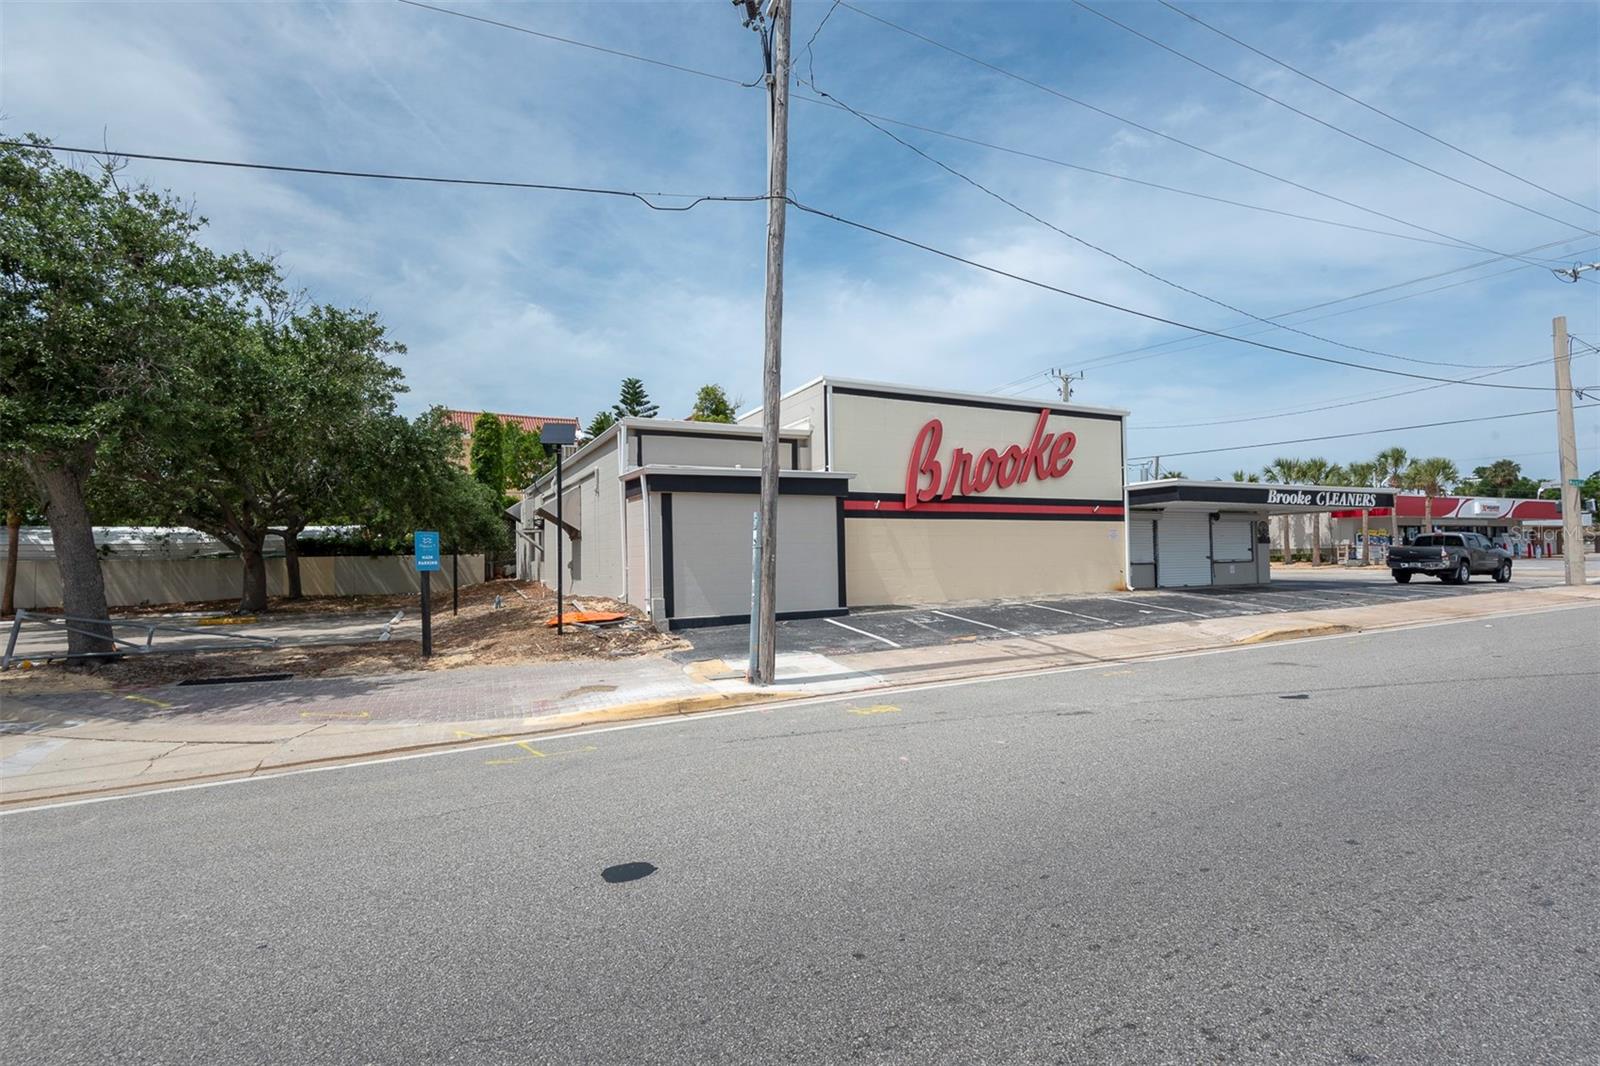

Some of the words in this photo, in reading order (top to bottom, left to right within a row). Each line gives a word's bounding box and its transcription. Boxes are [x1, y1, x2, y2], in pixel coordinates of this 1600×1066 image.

[905, 408, 1077, 510] Brooke
[1267, 489, 1311, 505] Brooke
[1316, 491, 1377, 507] CLEANERS
